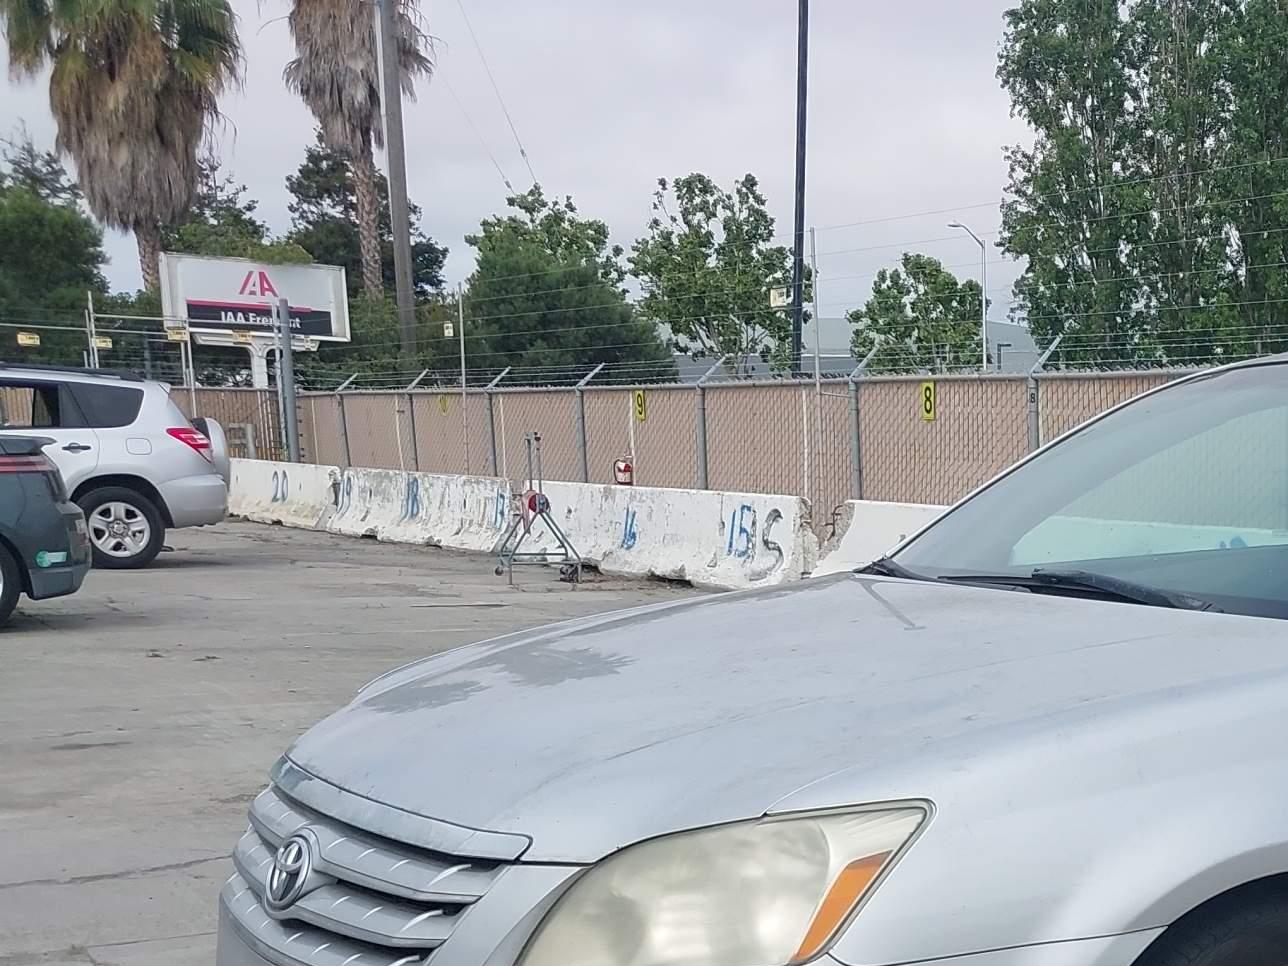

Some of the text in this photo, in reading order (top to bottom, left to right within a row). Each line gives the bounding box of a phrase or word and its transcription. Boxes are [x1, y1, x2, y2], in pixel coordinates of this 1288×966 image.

[221, 311, 246, 324] IAA
[636, 392, 644, 416] 9
[924, 385, 933, 414] 8
[271, 470, 288, 503] 20
